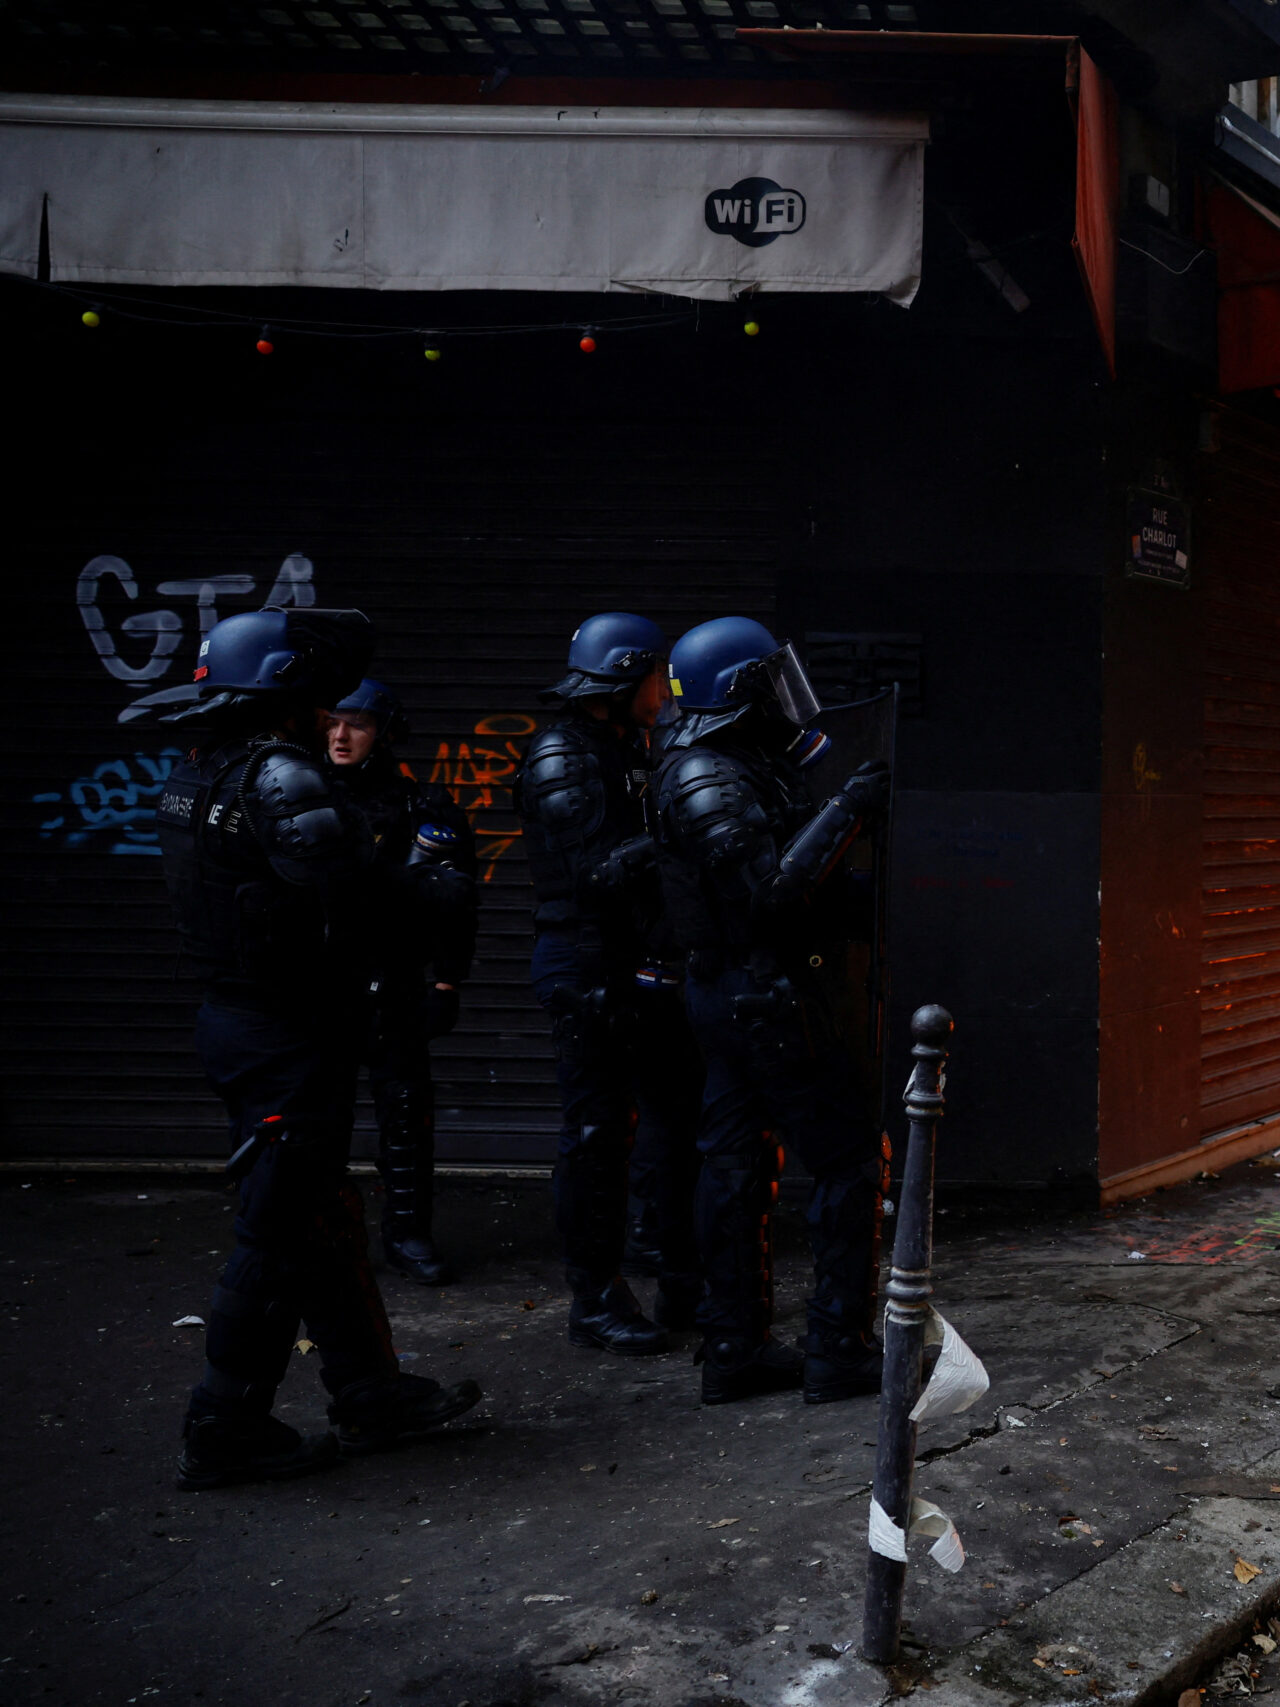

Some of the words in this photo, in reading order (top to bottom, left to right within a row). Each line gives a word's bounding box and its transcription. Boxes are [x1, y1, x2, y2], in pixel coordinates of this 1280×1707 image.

[1152, 508, 1168, 526] RUE
[1142, 526, 1177, 549] CHARLOT
[76, 552, 316, 684] GTA
